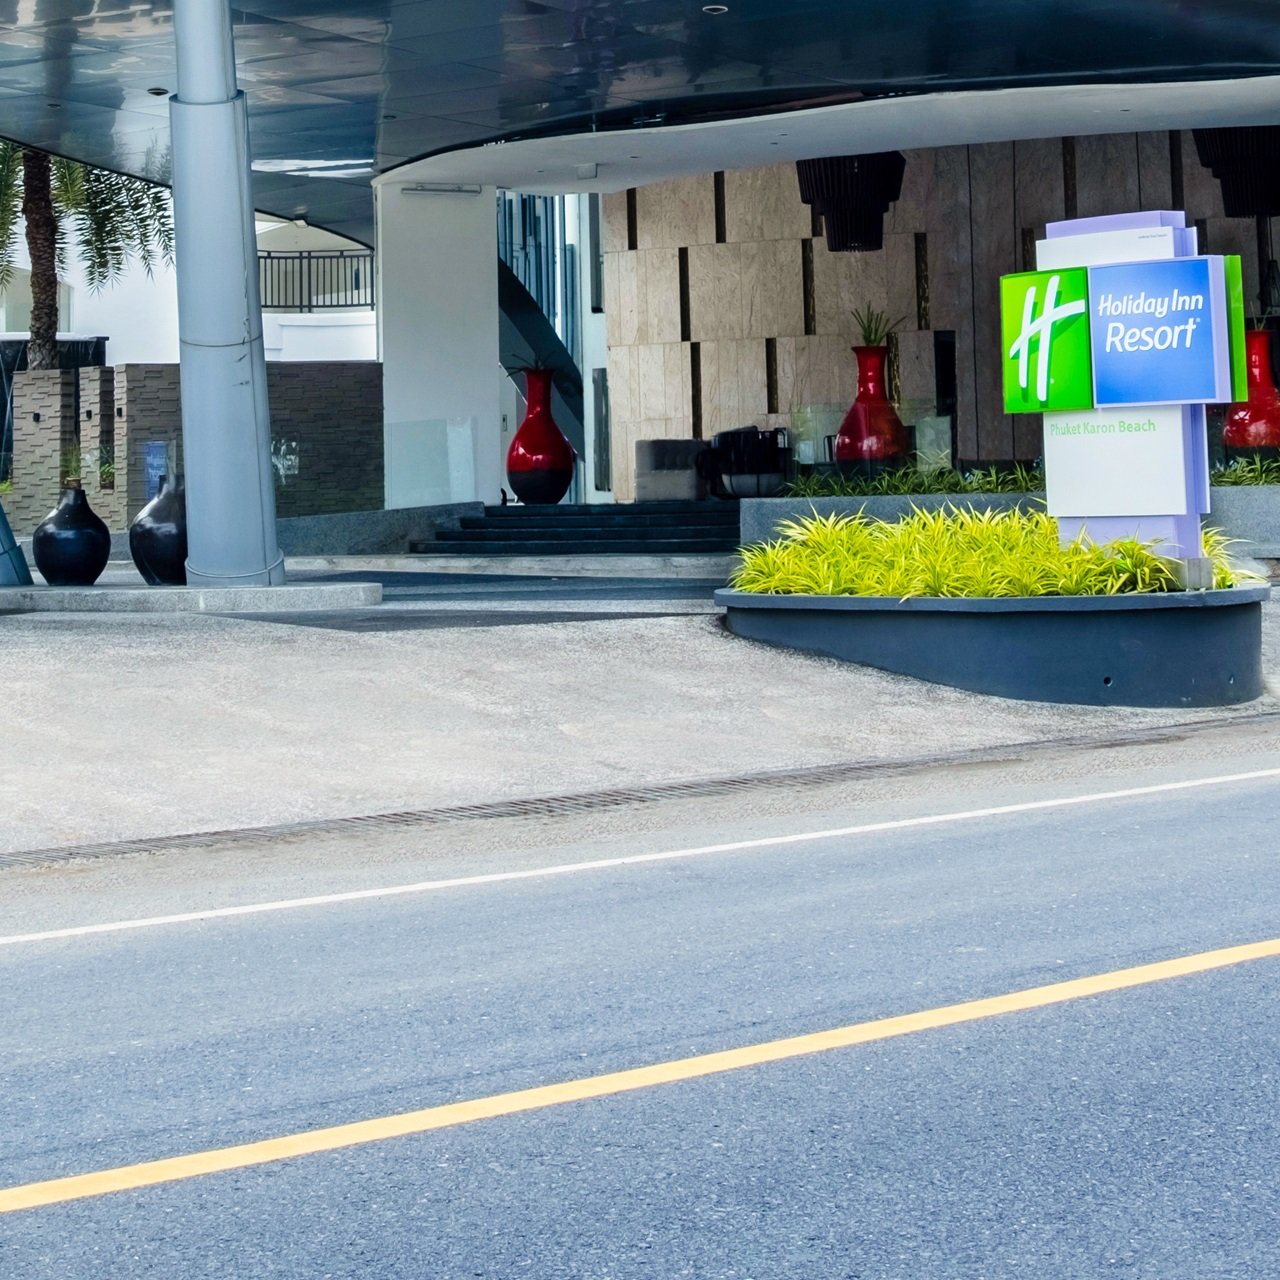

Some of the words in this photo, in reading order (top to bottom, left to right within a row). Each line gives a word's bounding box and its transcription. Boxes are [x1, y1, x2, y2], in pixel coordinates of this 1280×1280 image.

[1098, 291, 1169, 318] Holiday
[1171, 288, 1204, 312] Inn
[1105, 317, 1197, 353] Resort
[1050, 423, 1081, 436] Phuket
[1083, 422, 1116, 434] Karon
[1118, 419, 1156, 433] Beach
